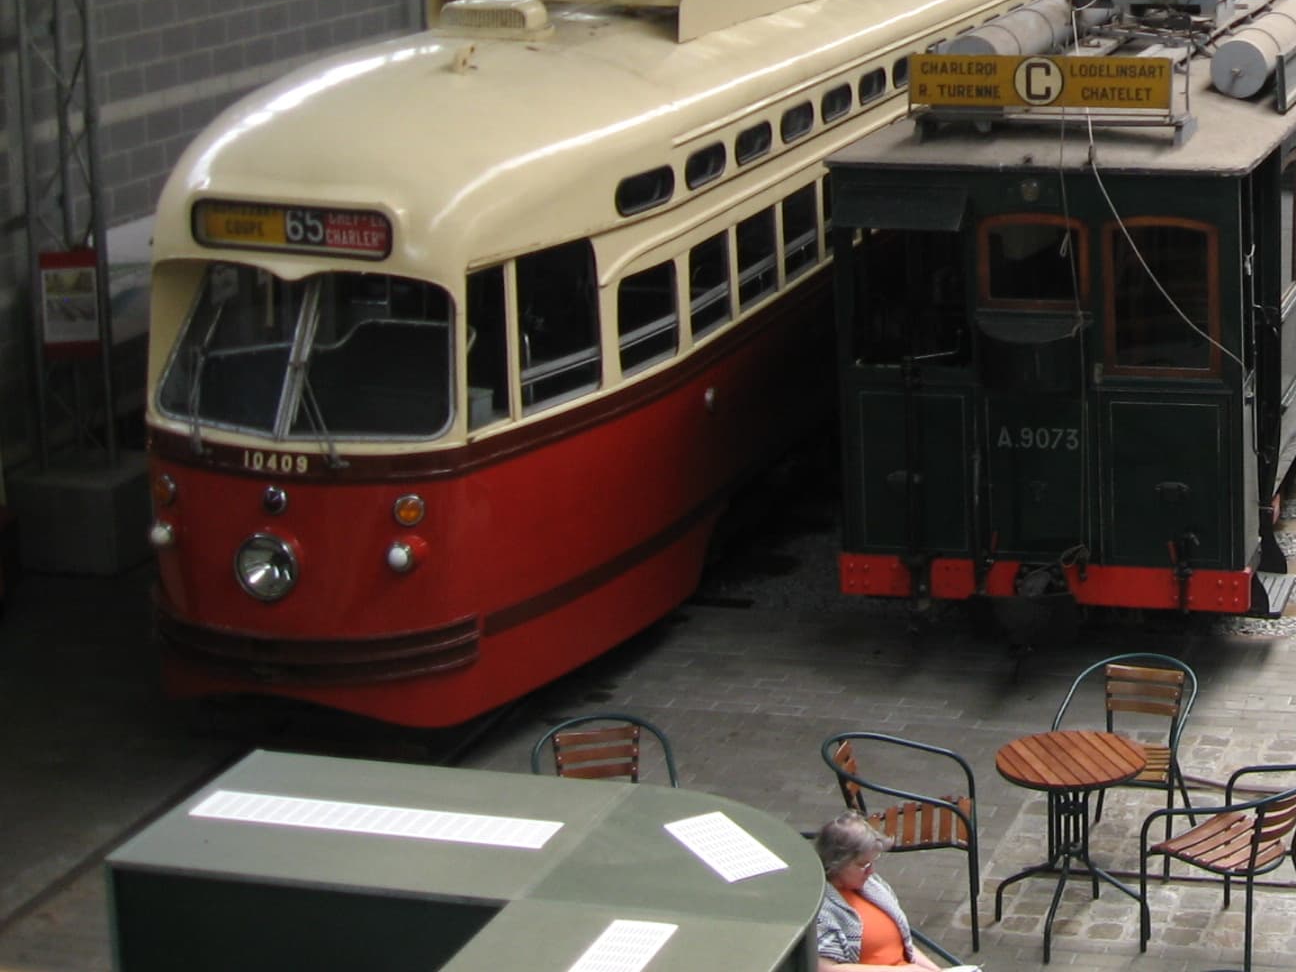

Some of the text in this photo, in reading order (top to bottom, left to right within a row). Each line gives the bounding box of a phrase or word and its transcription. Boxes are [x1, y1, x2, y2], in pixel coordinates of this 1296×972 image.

[920, 61, 998, 75] CHARLEROI
[1069, 63, 1165, 79] LODELINSART
[1025, 61, 1051, 100] C
[939, 84, 1001, 100] TURENNE
[1080, 86, 1153, 101] CHATELET
[285, 209, 325, 243] 65
[997, 426, 1080, 449] A.9073
[244, 450, 308, 473] 10409
